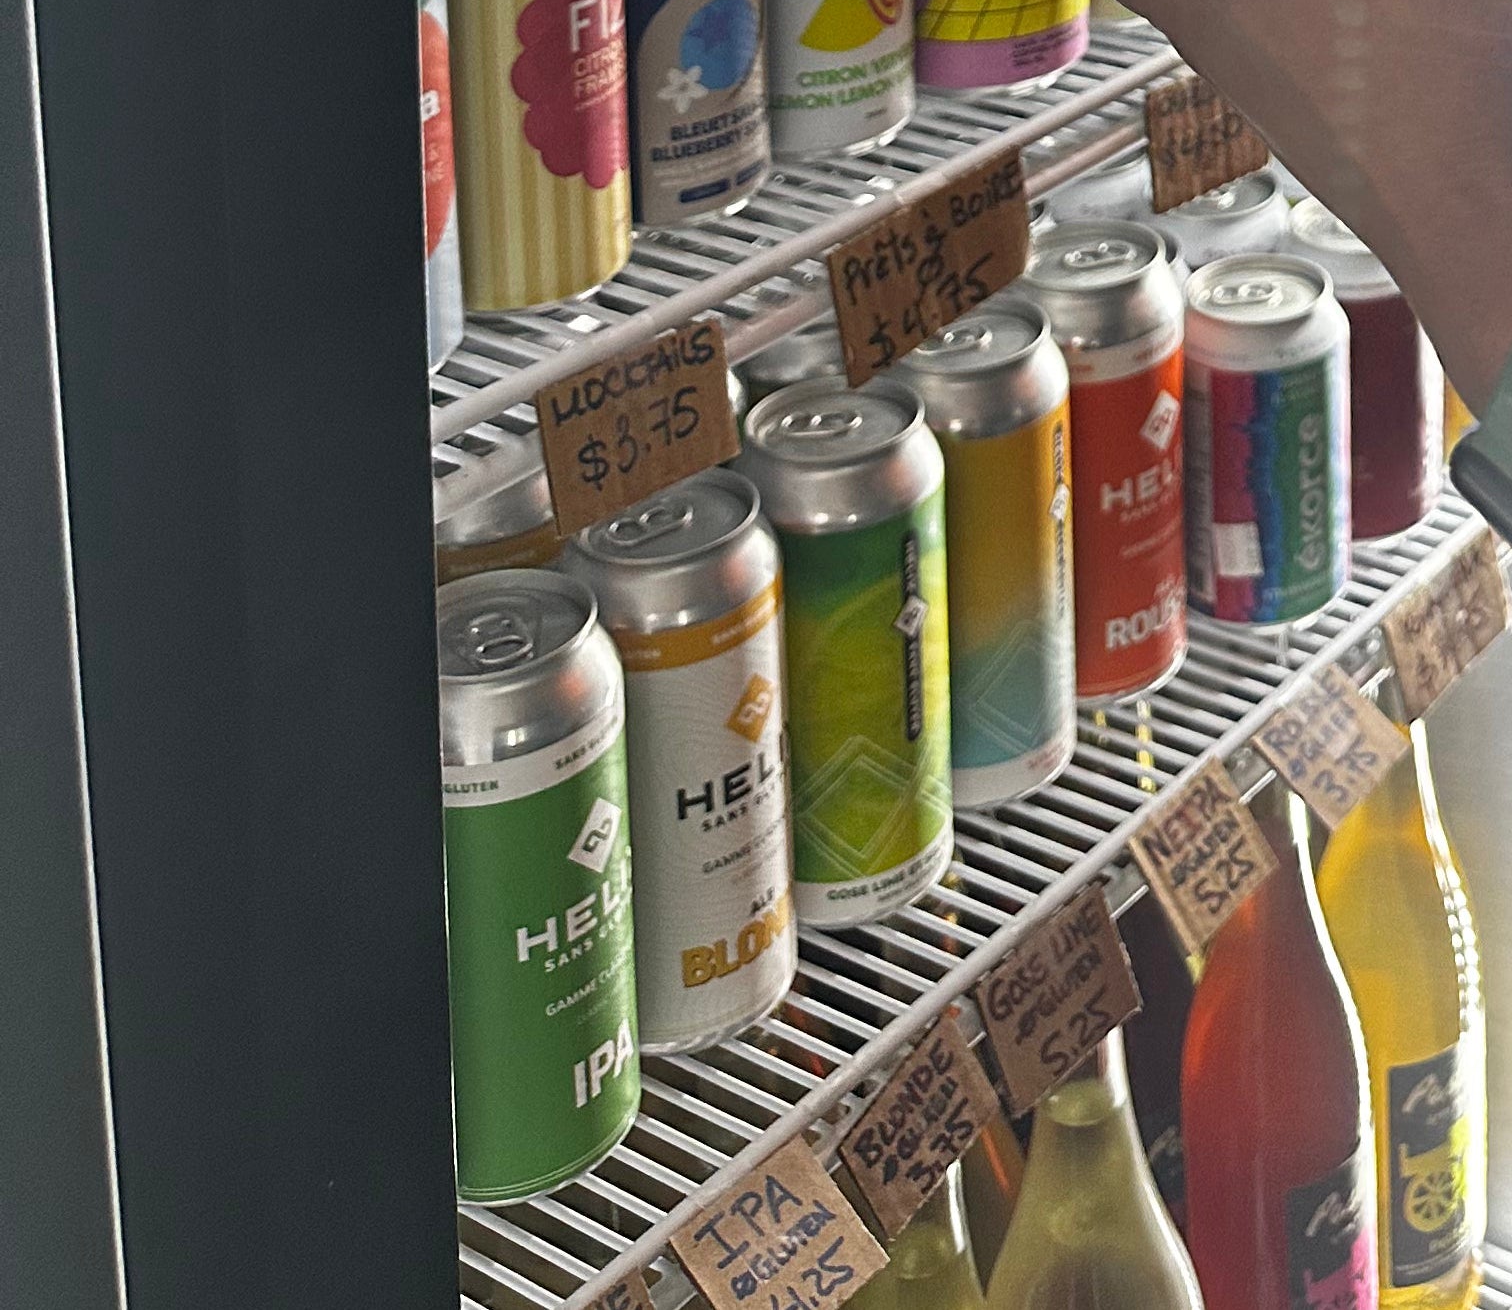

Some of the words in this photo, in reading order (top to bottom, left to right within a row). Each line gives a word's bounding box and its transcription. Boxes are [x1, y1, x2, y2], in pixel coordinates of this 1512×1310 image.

[799, 63, 869, 87] CITRON
[544, 937, 594, 973] SANS
[545, 978, 598, 1016] GAMME
[573, 1016, 635, 1109] IPA
[854, 1037, 955, 1169] BLONDE
[694, 1174, 804, 1270] IPA
